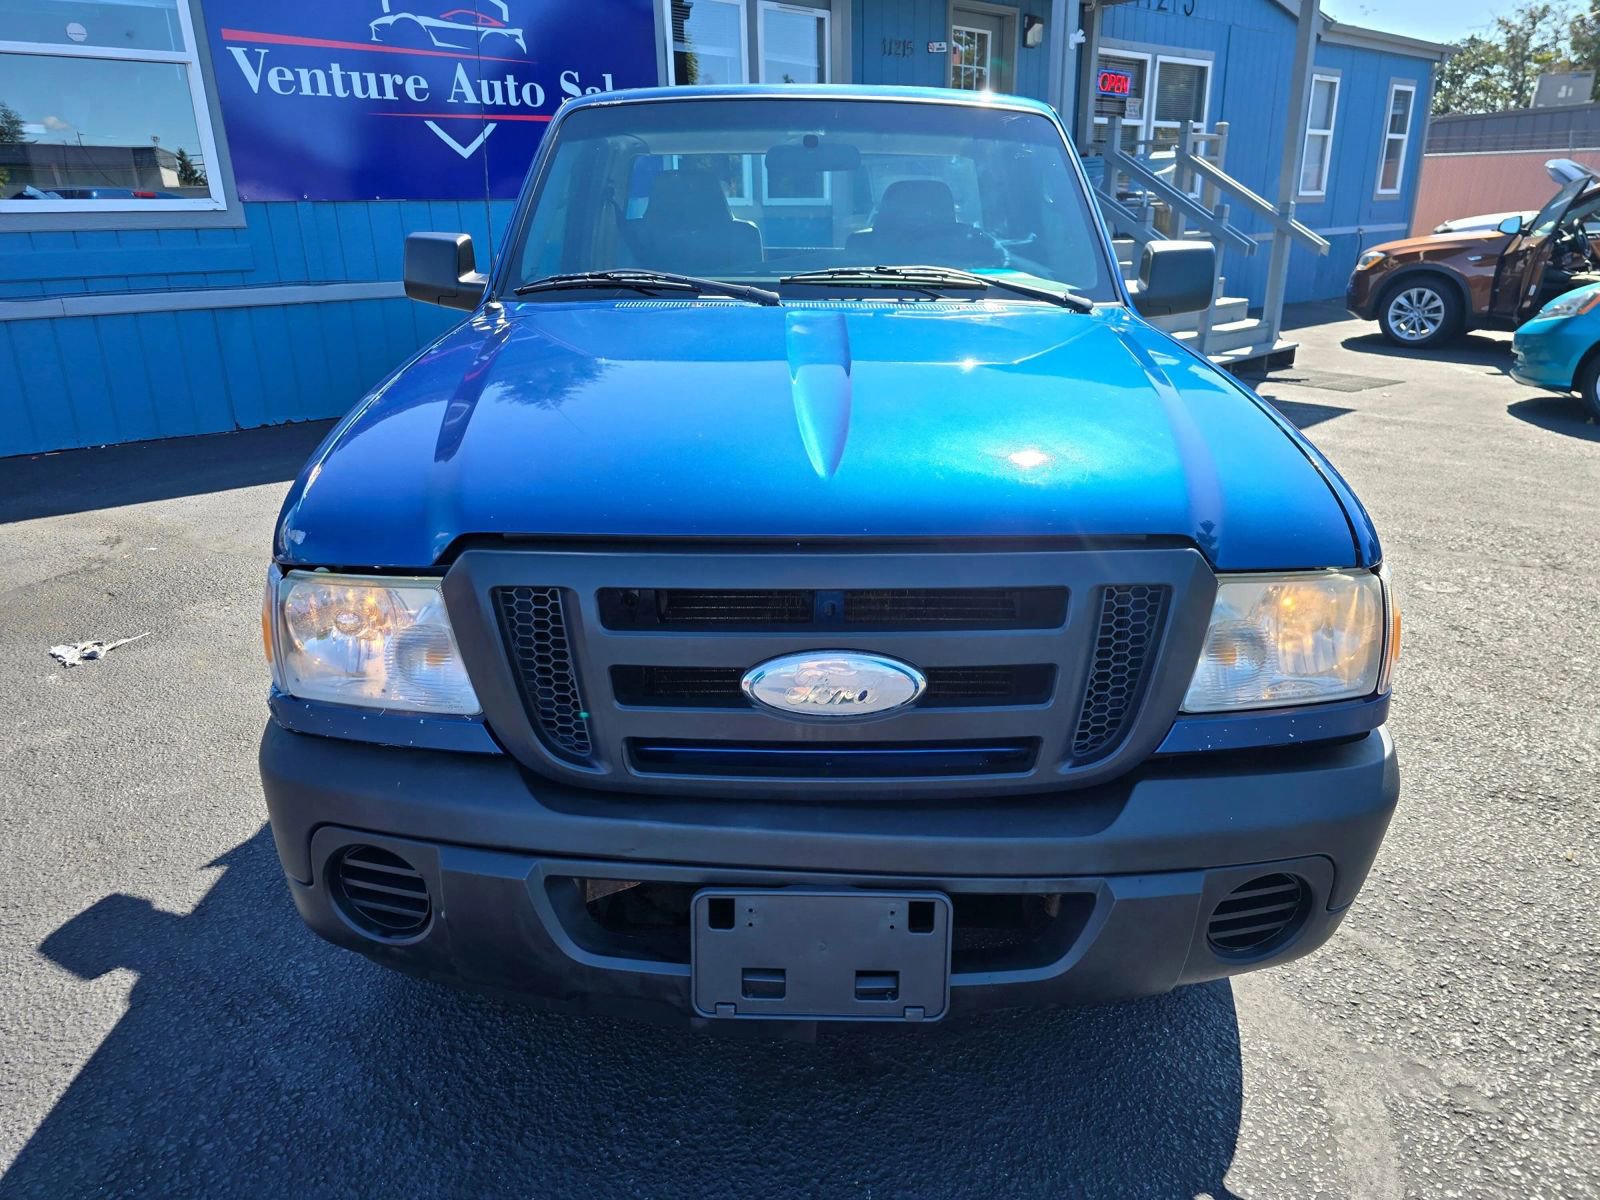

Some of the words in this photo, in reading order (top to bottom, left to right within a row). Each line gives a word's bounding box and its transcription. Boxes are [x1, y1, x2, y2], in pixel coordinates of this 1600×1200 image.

[226, 46, 430, 101] Venture
[446, 62, 545, 108] Auto
[1099, 73, 1129, 94] OPEN
[784, 661, 882, 705] Ford
